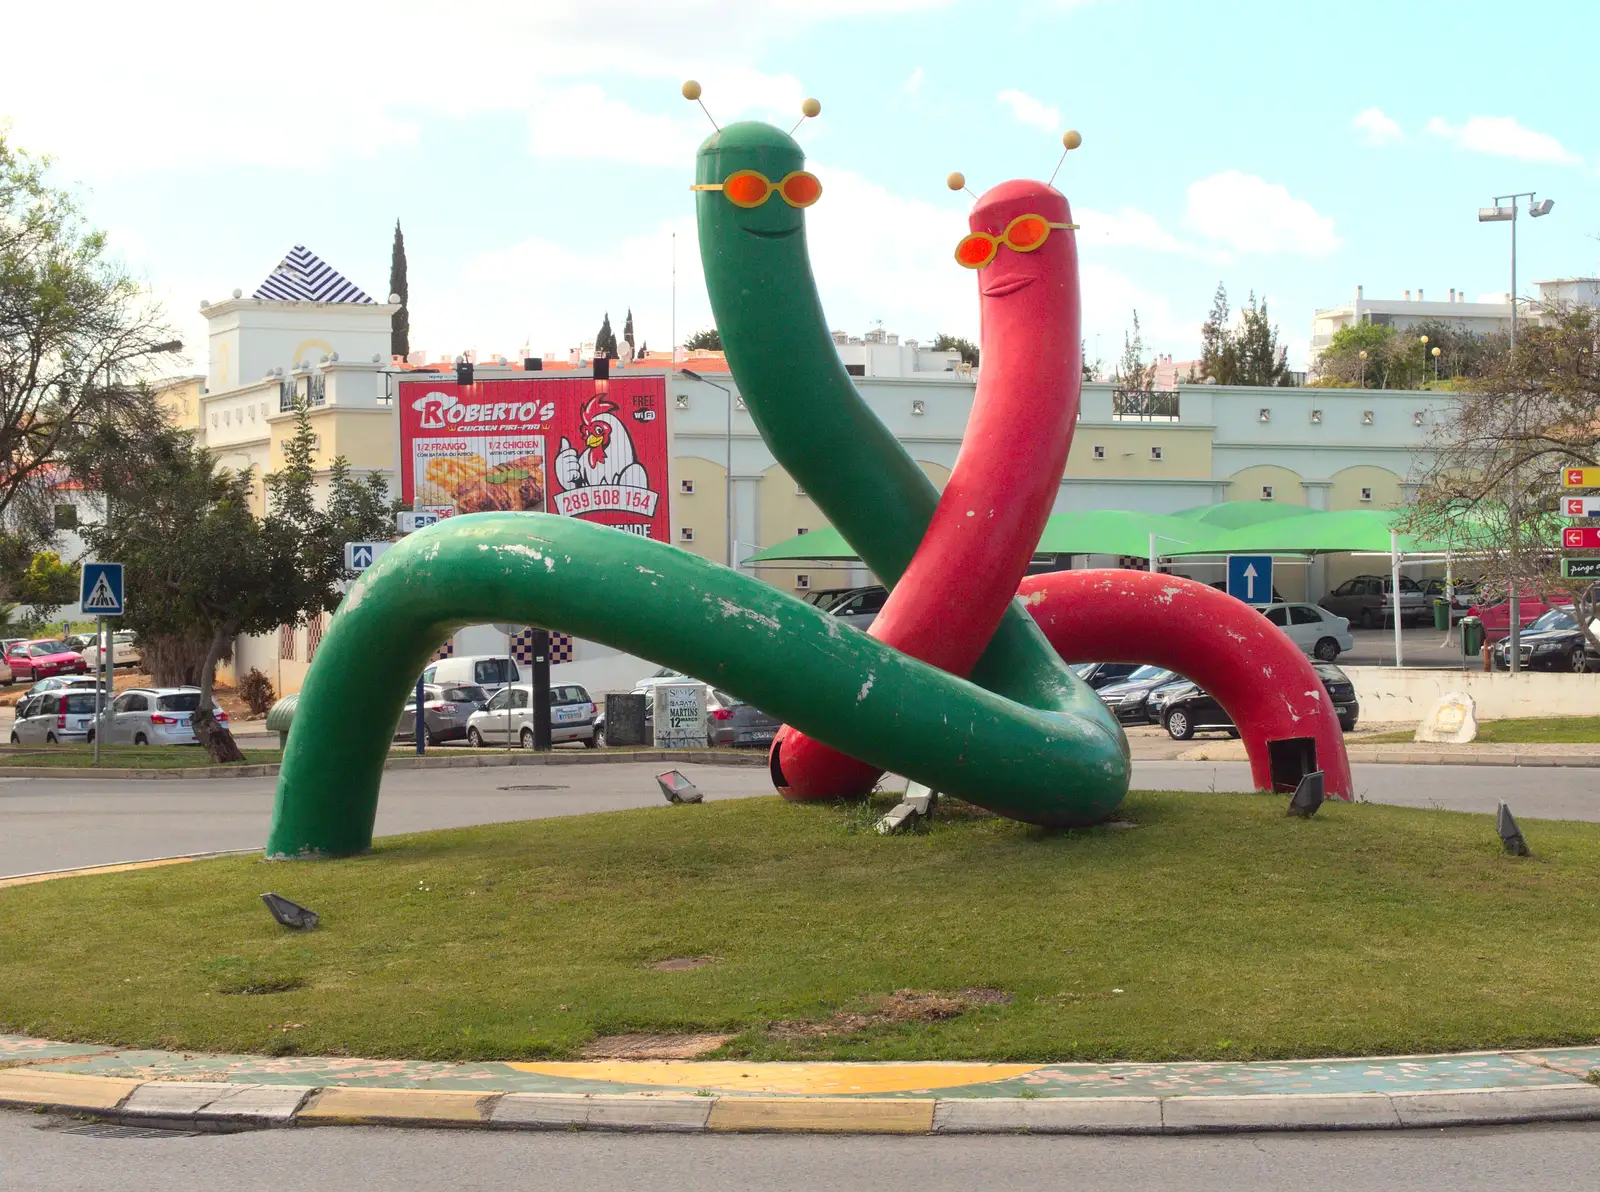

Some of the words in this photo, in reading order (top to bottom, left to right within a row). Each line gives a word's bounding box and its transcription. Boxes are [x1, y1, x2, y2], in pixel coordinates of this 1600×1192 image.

[632, 395, 655, 407] FREE
[420, 399, 555, 429] ROBERTO'S
[457, 424, 498, 432] CHICKEN
[499, 423, 541, 432] PIRI-PIRI
[416, 443, 429, 451] 1/2
[431, 442, 467, 451] FRANGO
[488, 441, 501, 450] 1/2
[503, 440, 539, 449] CHICKEN
[562, 492, 590, 513] 289
[593, 489, 620, 506] 508
[625, 490, 651, 510] 154
[1570, 564, 1595, 575] pingo
[669, 708, 699, 717] MARTINS
[670, 717, 681, 728] 12
